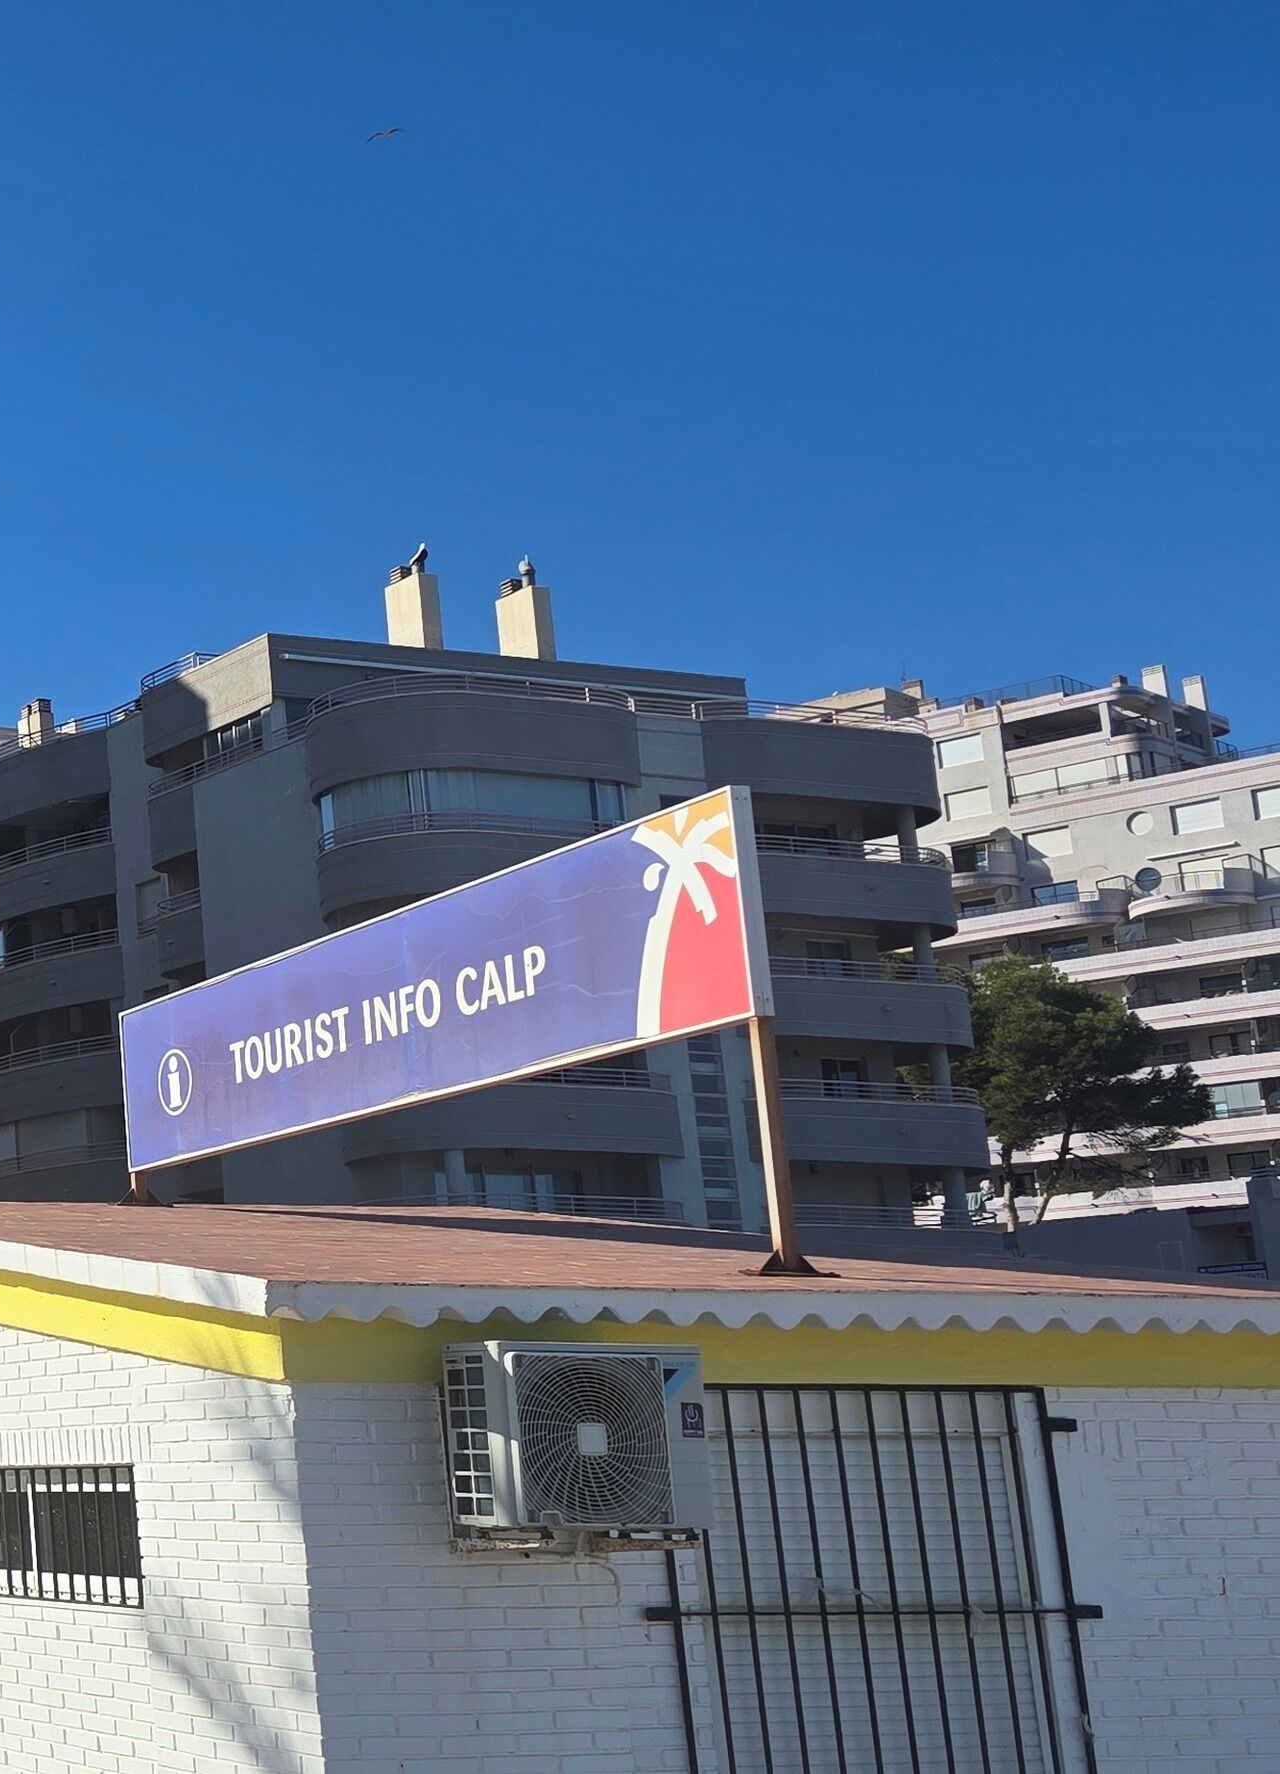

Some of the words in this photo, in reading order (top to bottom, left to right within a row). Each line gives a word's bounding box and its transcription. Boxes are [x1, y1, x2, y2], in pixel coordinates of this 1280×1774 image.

[229, 1006, 349, 1084] TOURIST
[362, 978, 442, 1045] INFO
[455, 945, 547, 1017] CALP
